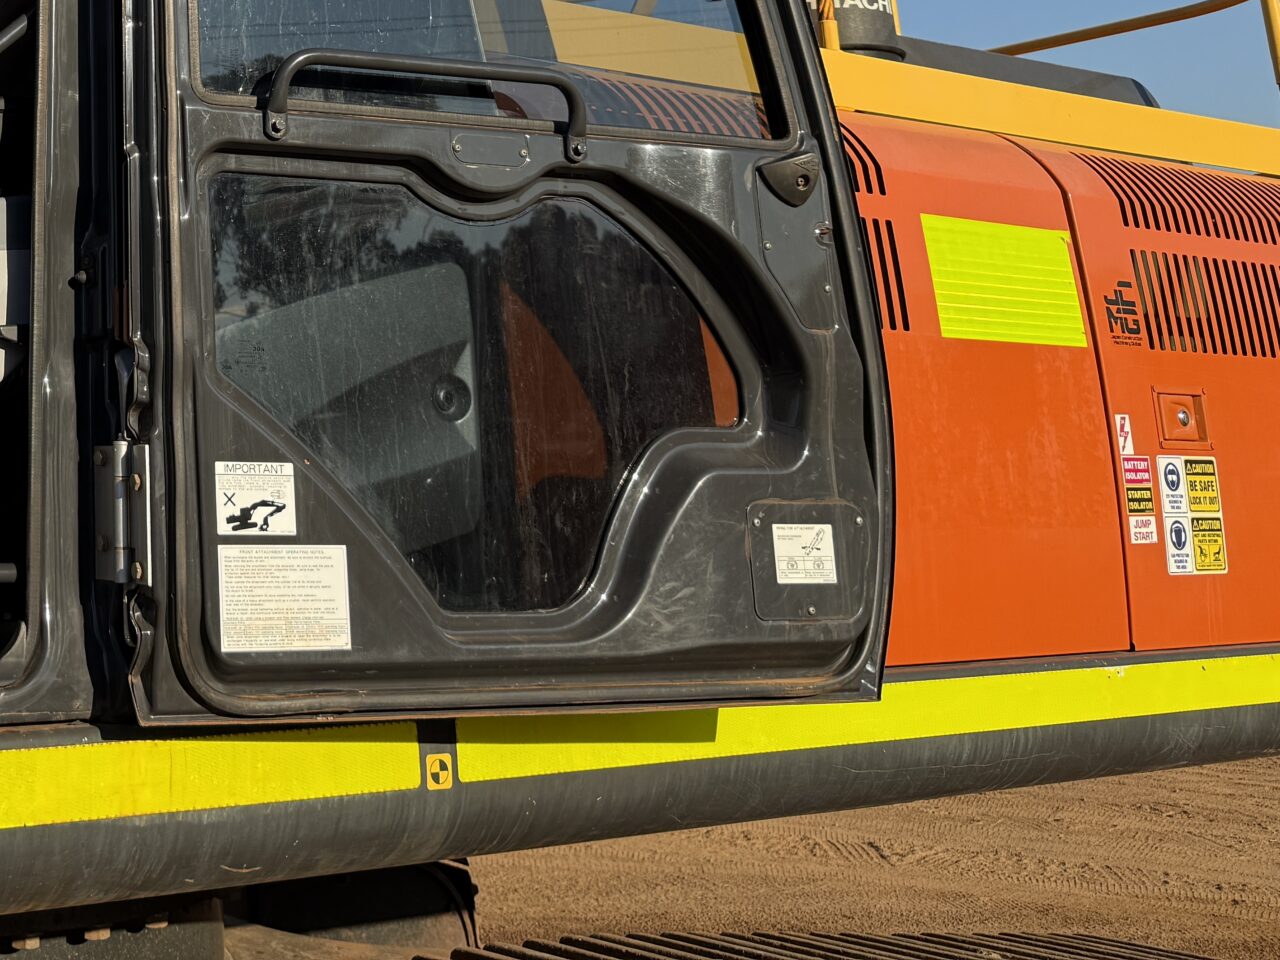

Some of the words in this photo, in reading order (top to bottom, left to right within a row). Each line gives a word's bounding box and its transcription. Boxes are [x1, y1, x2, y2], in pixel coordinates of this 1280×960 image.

[223, 463, 285, 475] IMPORTANT
[1124, 461, 1148, 470] BATTERY
[1192, 464, 1214, 473] CAUTION
[1189, 480, 1198, 492] BE
[1199, 480, 1215, 492] SAFE
[1128, 491, 1151, 499] STARTER
[1190, 496, 1202, 505] LOCK
[1203, 496, 1208, 505] IT
[1209, 496, 1218, 505] OUT
[1134, 519, 1151, 528] JUMP
[1199, 520, 1221, 530] CAUTION
[1134, 532, 1153, 541] START
